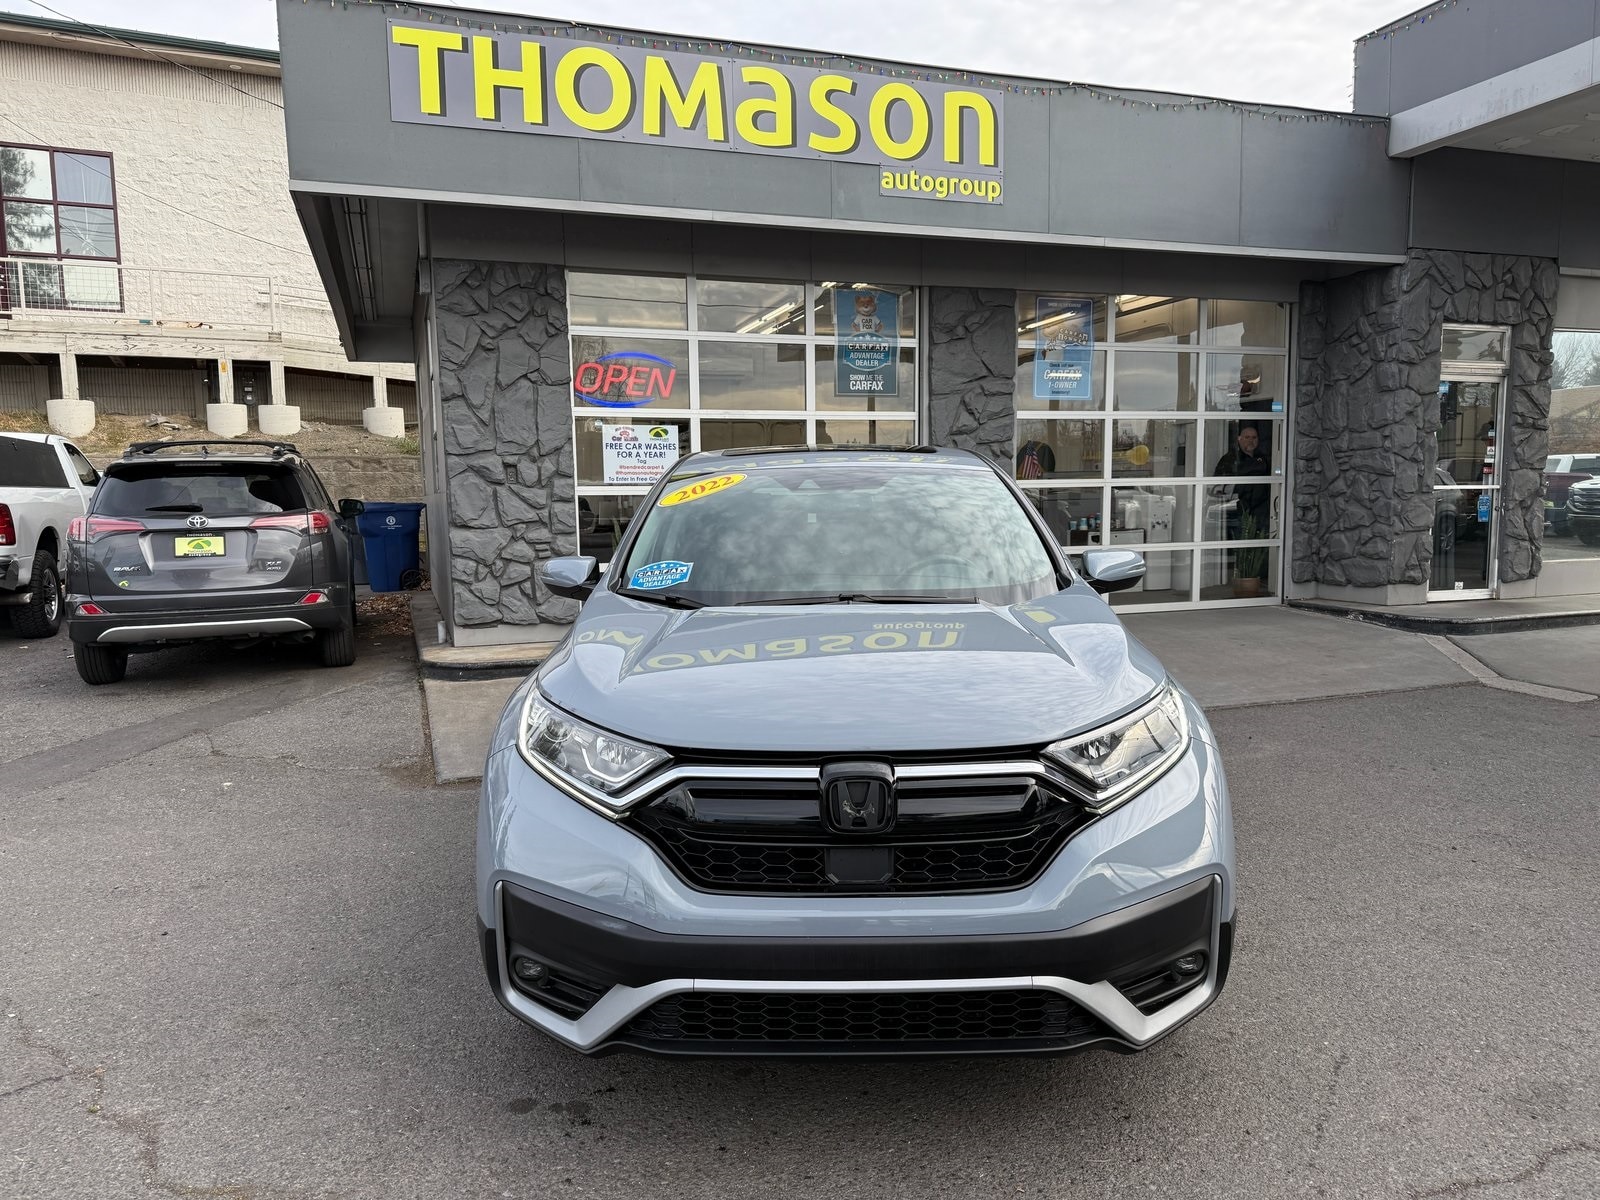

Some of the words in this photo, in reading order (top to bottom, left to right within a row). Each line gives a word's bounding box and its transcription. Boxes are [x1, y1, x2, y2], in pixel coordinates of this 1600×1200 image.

[881, 168, 1002, 202] autogroup
[848, 342, 889, 352] CARFAX
[849, 352, 884, 360] ADVANTAGE
[855, 359, 879, 367] DEALER
[574, 362, 676, 398] OPEN
[849, 381, 884, 391] CARFAX
[1049, 381, 1077, 389] 1-OWNER
[605, 442, 623, 450] FREE
[625, 442, 643, 450] CAR
[645, 443, 677, 451] WASHES
[617, 451, 633, 459] FOR
[635, 451, 642, 459] A
[643, 451, 666, 459] YEAR!
[675, 476, 734, 501] 2022
[638, 574, 682, 584] ADVANTAGE
[643, 579, 672, 588] DEALER
